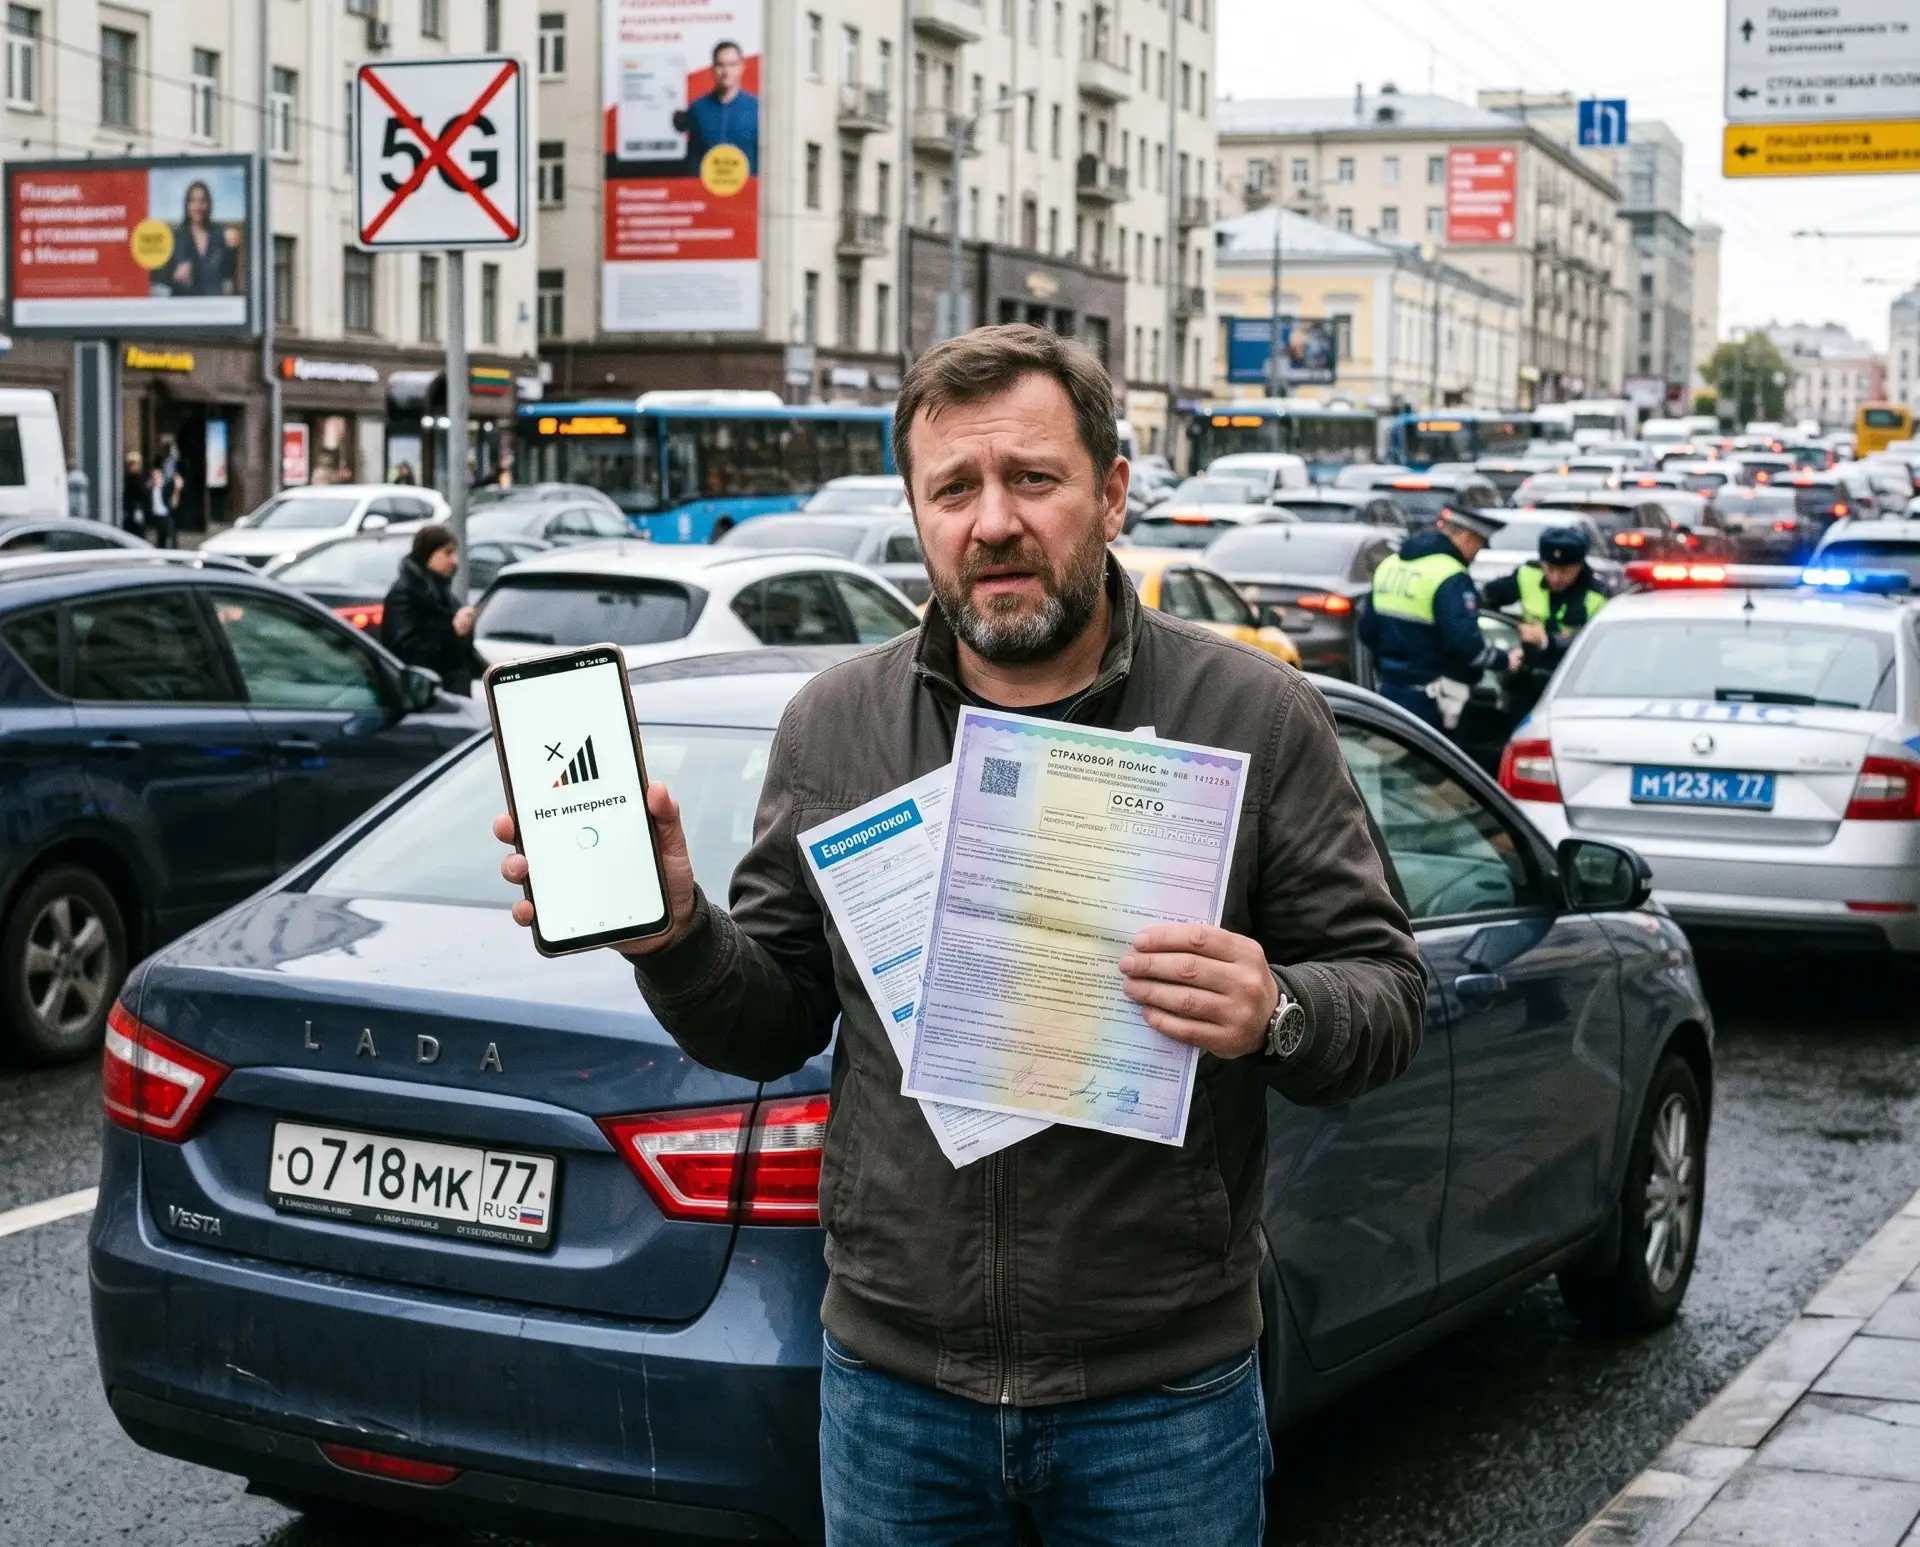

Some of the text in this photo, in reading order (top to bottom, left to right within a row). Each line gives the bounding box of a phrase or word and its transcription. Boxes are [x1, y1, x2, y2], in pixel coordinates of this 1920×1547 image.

[380, 114, 498, 193] 5G
[1050, 748, 1114, 767] СТРАХОВОЙ
[1118, 760, 1157, 774] ПОЛИС
[1195, 774, 1230, 787] 1412259
[1112, 794, 1164, 812] ОСАГО
[1735, 776, 1765, 798] 77
[534, 794, 627, 821] Нет интернета
[820, 809, 913, 859] Европротокол
[304, 1020, 504, 1073] LADA
[490, 1157, 539, 1204] 77
[168, 1205, 222, 1237] VESTA
[483, 1201, 518, 1221] RUS
